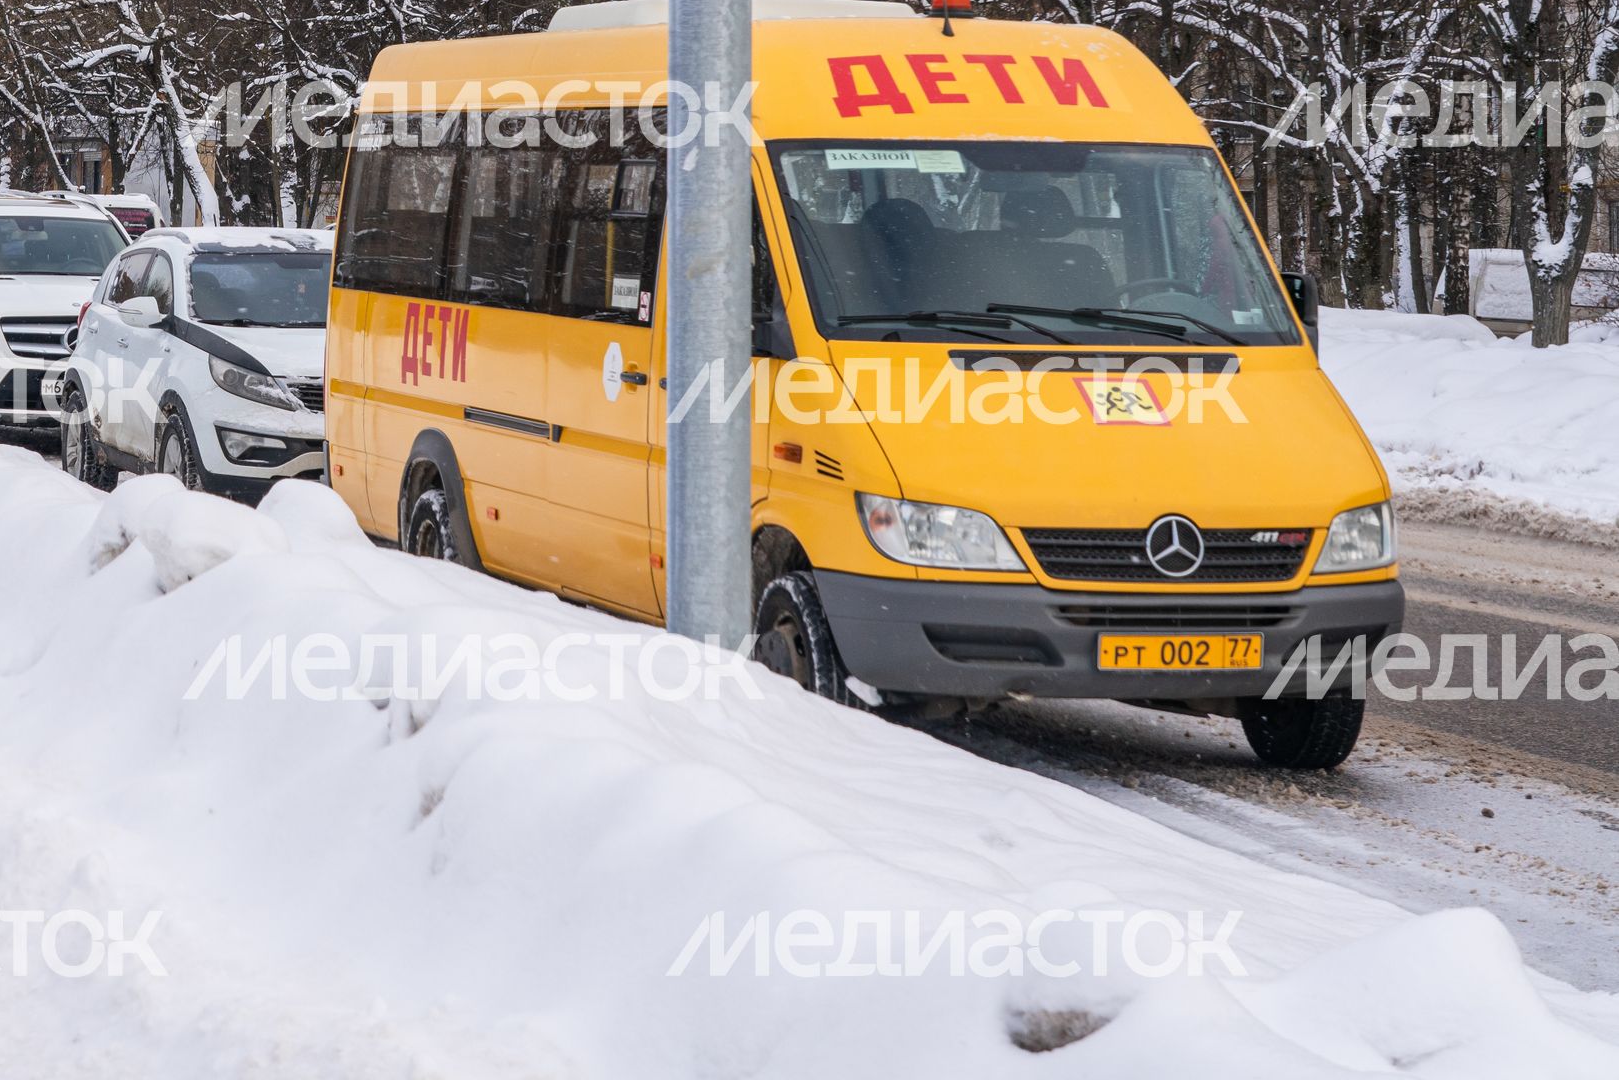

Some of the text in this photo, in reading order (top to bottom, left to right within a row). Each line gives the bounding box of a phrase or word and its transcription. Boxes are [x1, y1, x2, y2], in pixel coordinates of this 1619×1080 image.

[827, 53, 1109, 118] ДЕТИ
[830, 151, 911, 161] ЗАКАЗНОЙ
[401, 302, 470, 387] ДЕТИ
[1159, 640, 1210, 666] 002
[1228, 638, 1252, 658] 77
[1229, 659, 1249, 667] RUS
